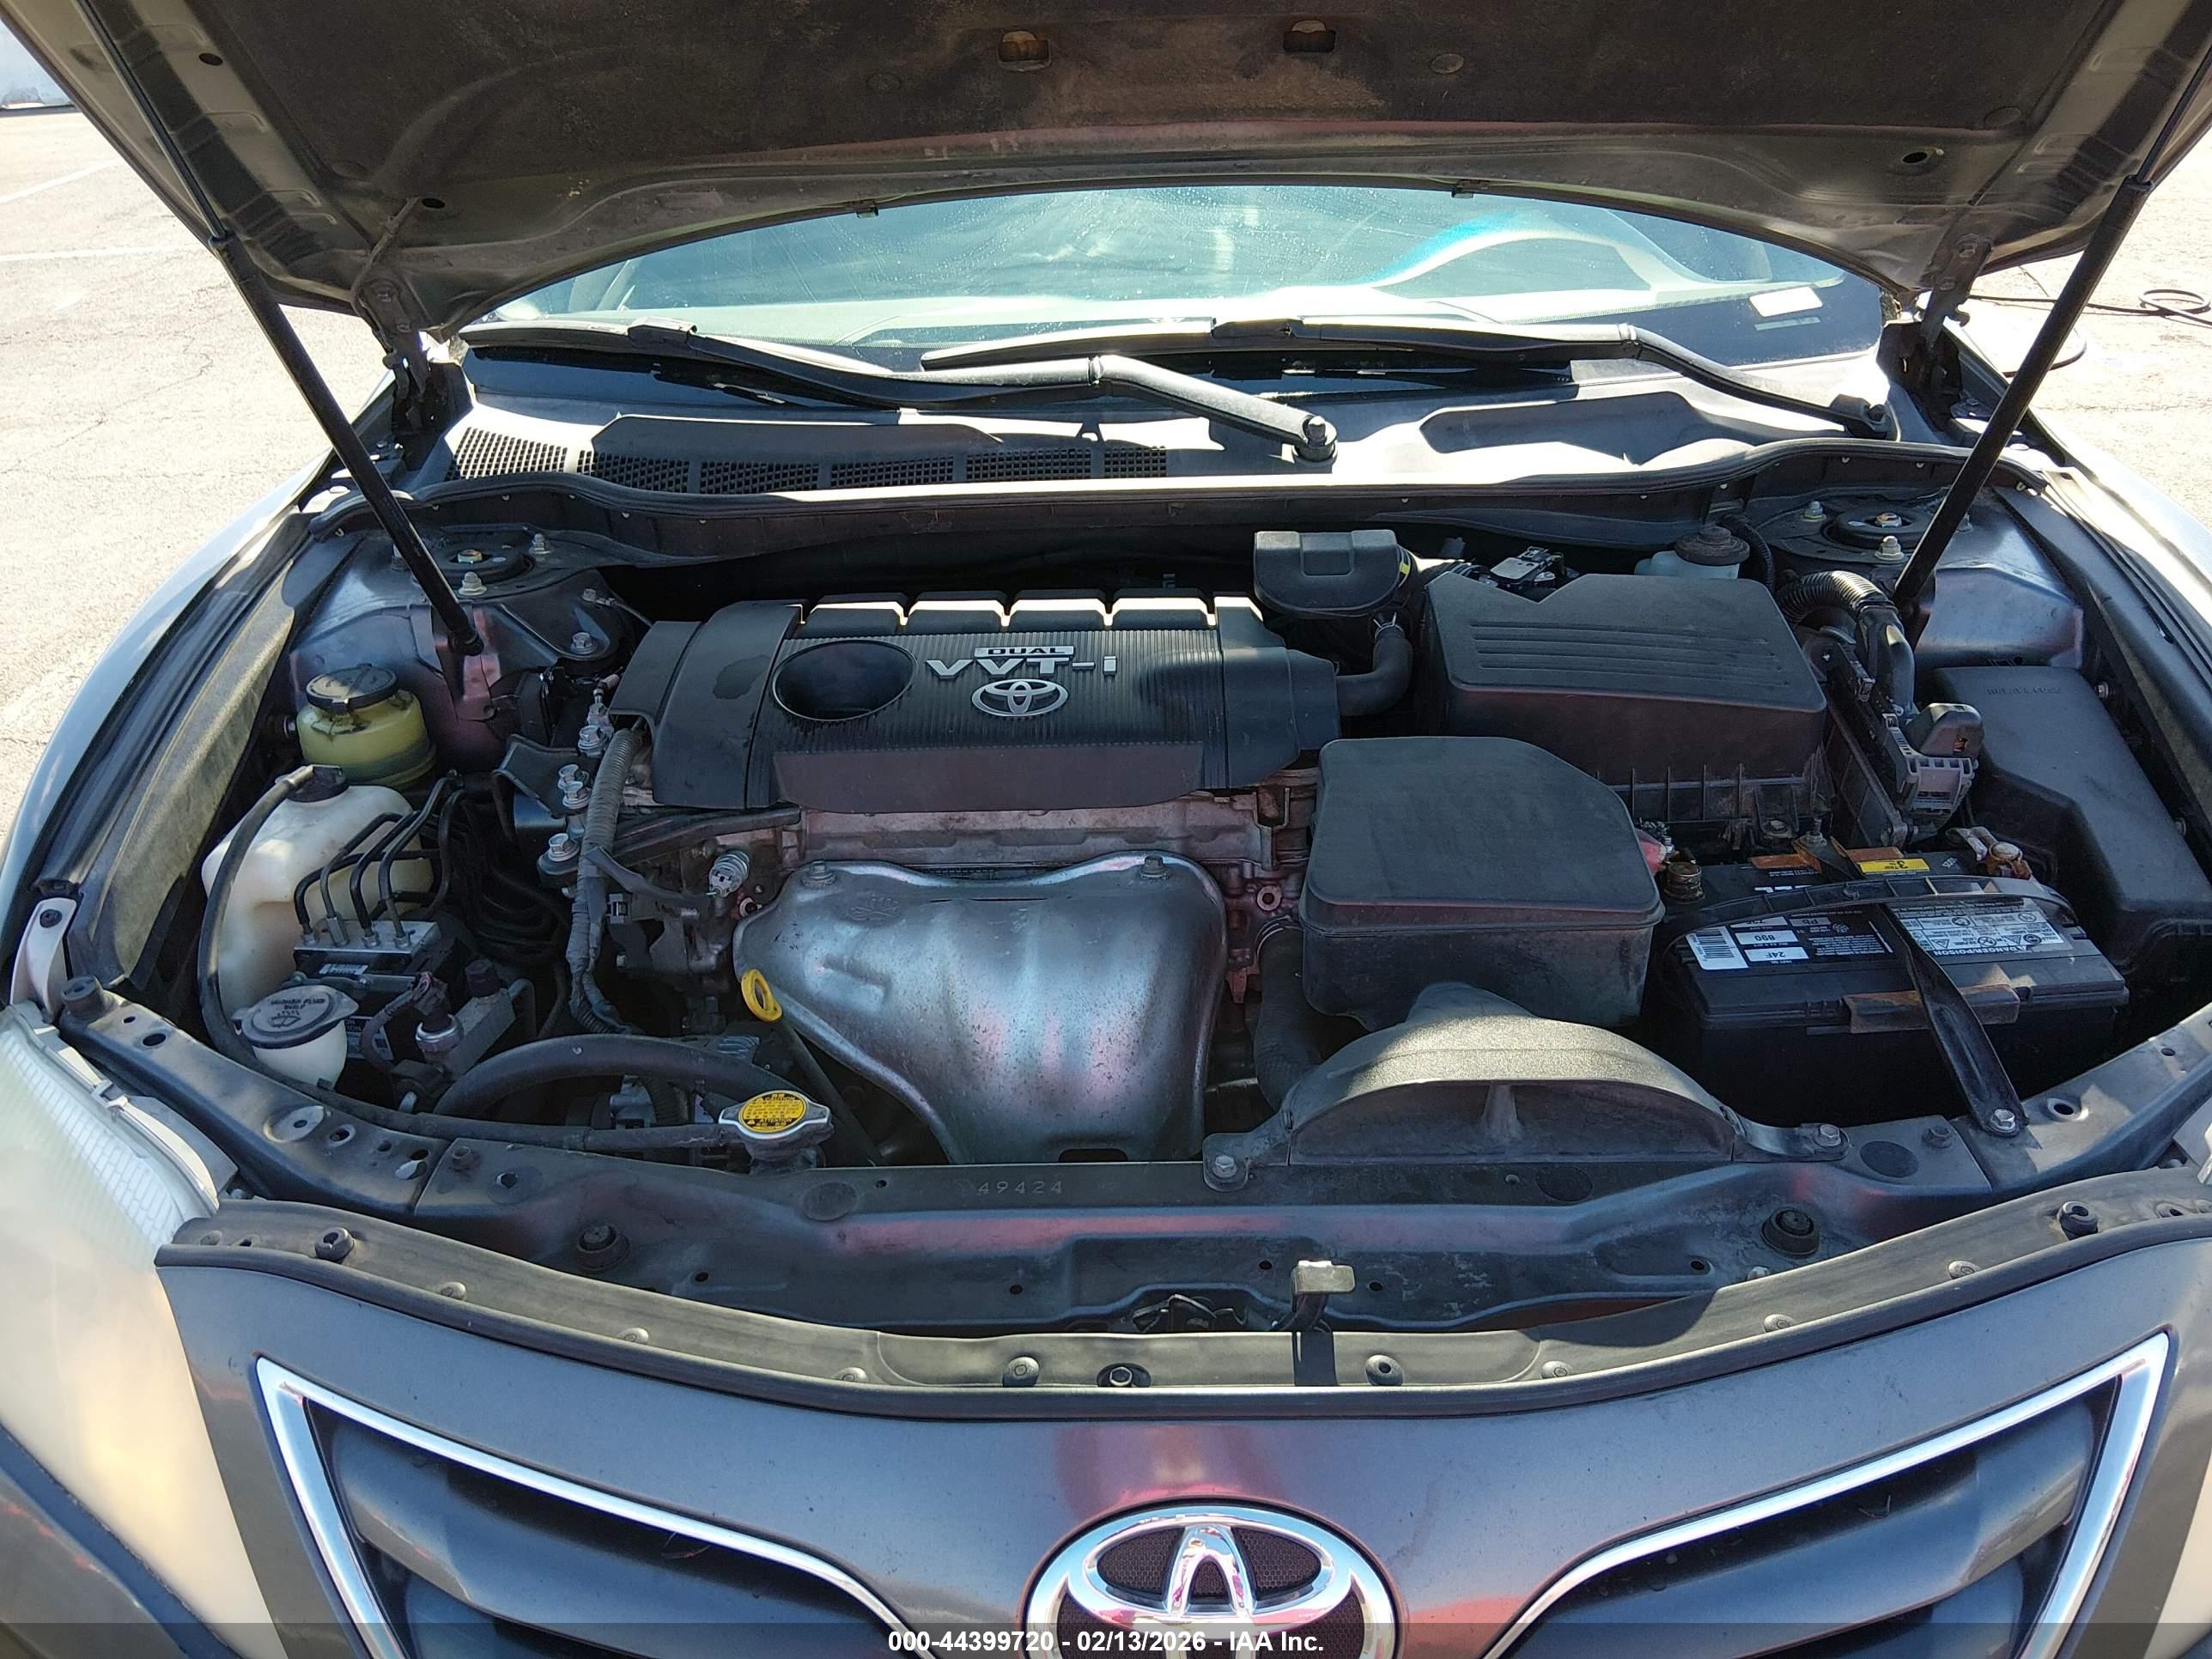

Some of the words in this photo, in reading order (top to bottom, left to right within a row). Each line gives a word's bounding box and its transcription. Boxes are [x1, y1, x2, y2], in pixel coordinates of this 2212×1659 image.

[925, 655, 1117, 679] VVT-i
[1933, 945, 2018, 956] DANGER/POISON
[976, 1181, 1063, 1195] 49424
